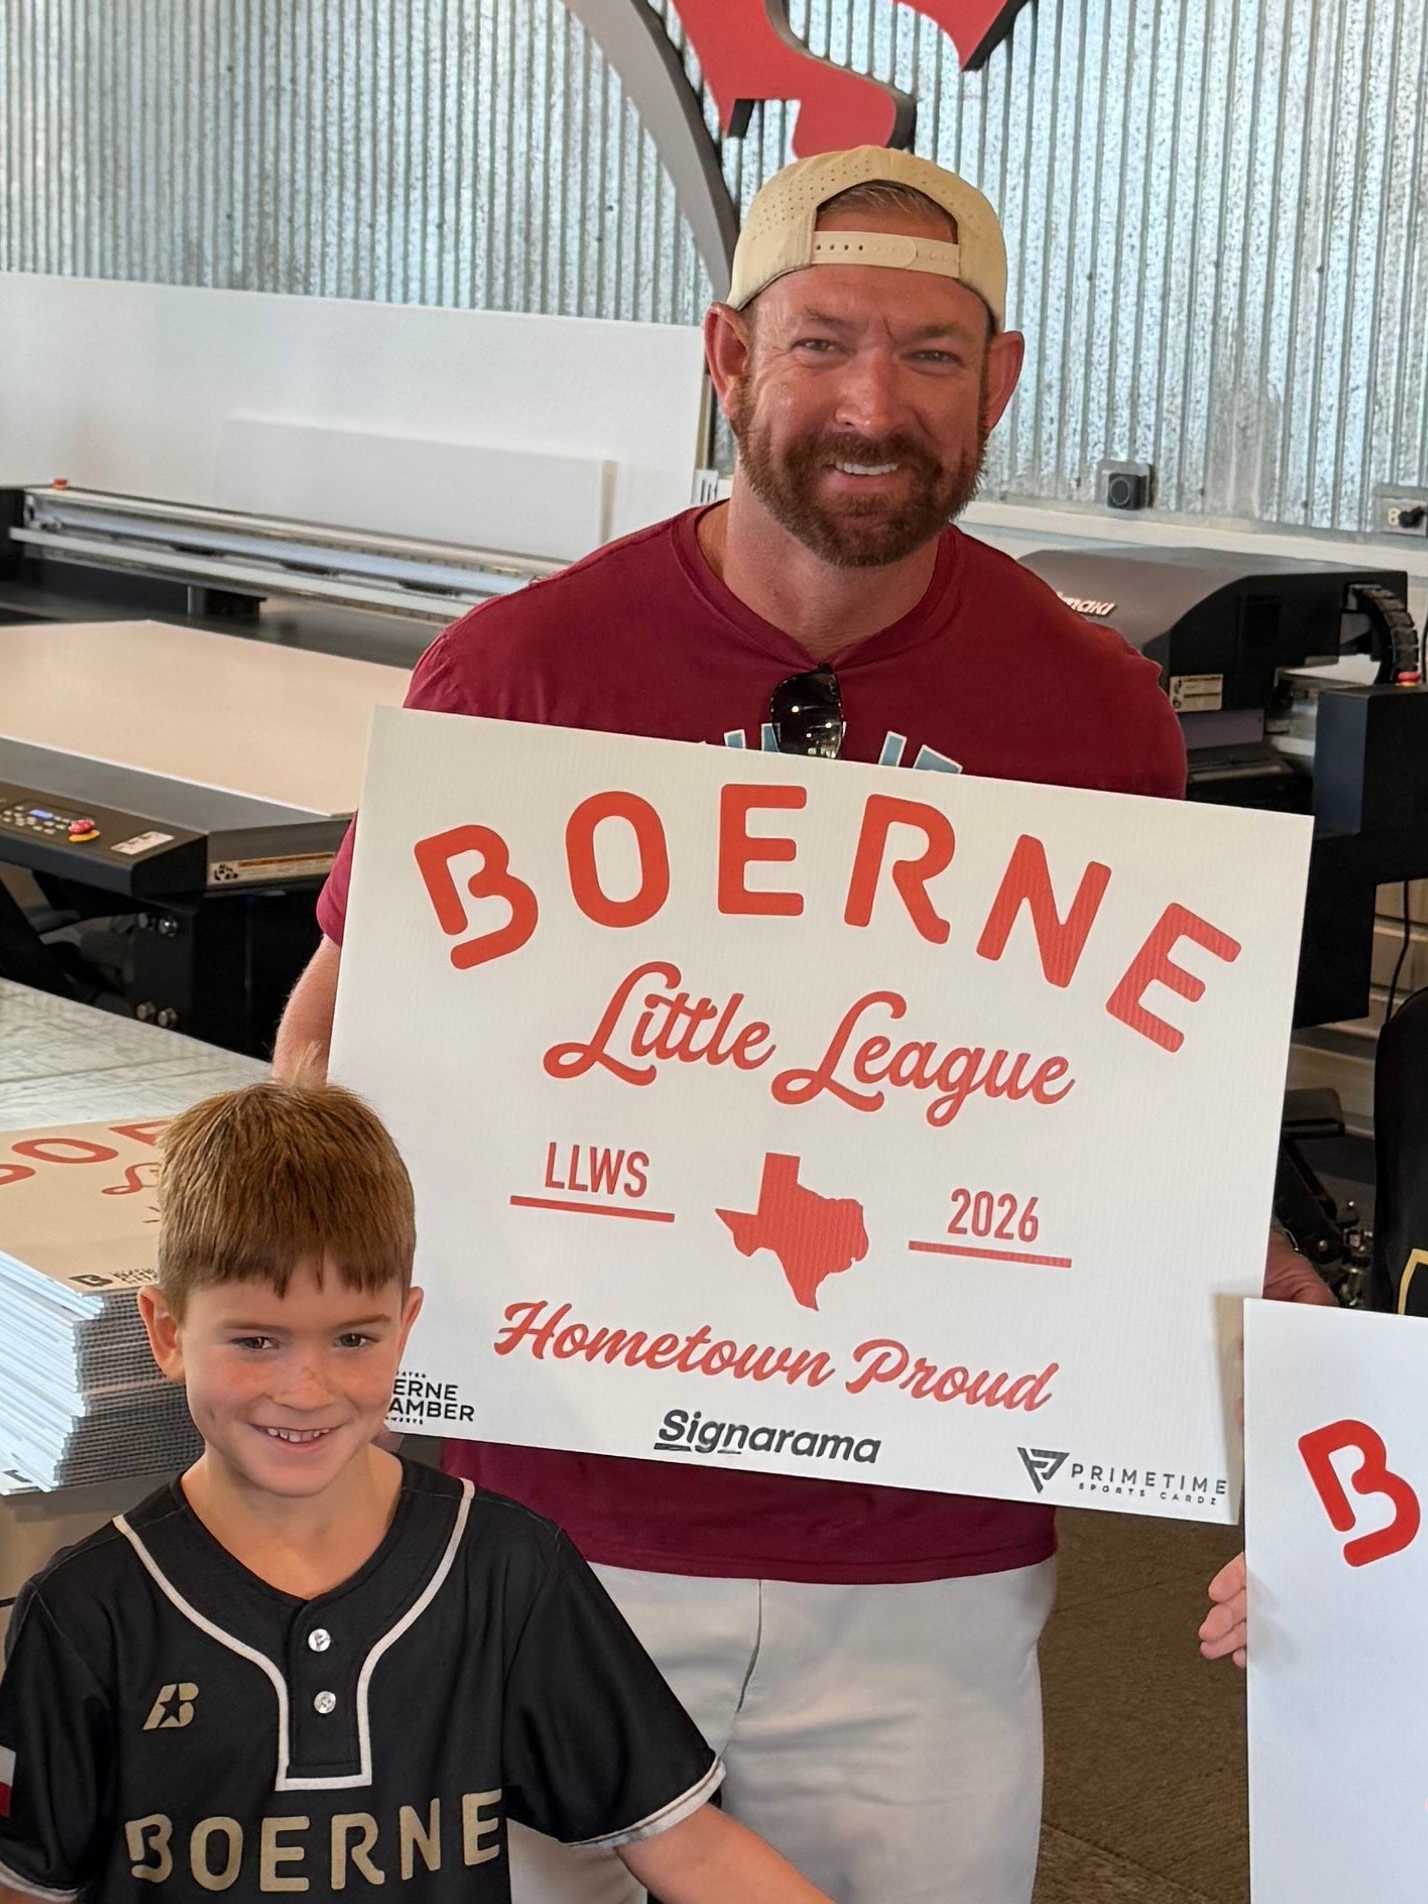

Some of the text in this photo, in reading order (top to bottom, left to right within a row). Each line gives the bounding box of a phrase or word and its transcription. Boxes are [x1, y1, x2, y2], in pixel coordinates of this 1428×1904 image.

[1056, 591, 1115, 615] maki
[413, 784, 1241, 1053] BOERNE
[542, 962, 1072, 1127] Little League
[543, 1139, 650, 1200] LLWS
[946, 1185, 1040, 1244] 2026
[495, 1302, 1057, 1411] Hometown Proud
[388, 1397, 474, 1422] AMBER
[393, 1379, 458, 1401] ERNE
[657, 1410, 882, 1464] Signarama
[1072, 1463, 1227, 1495] PRIMETIME
[1079, 1483, 1145, 1497] SPORTS
[124, 1788, 502, 1892] BOERNE
